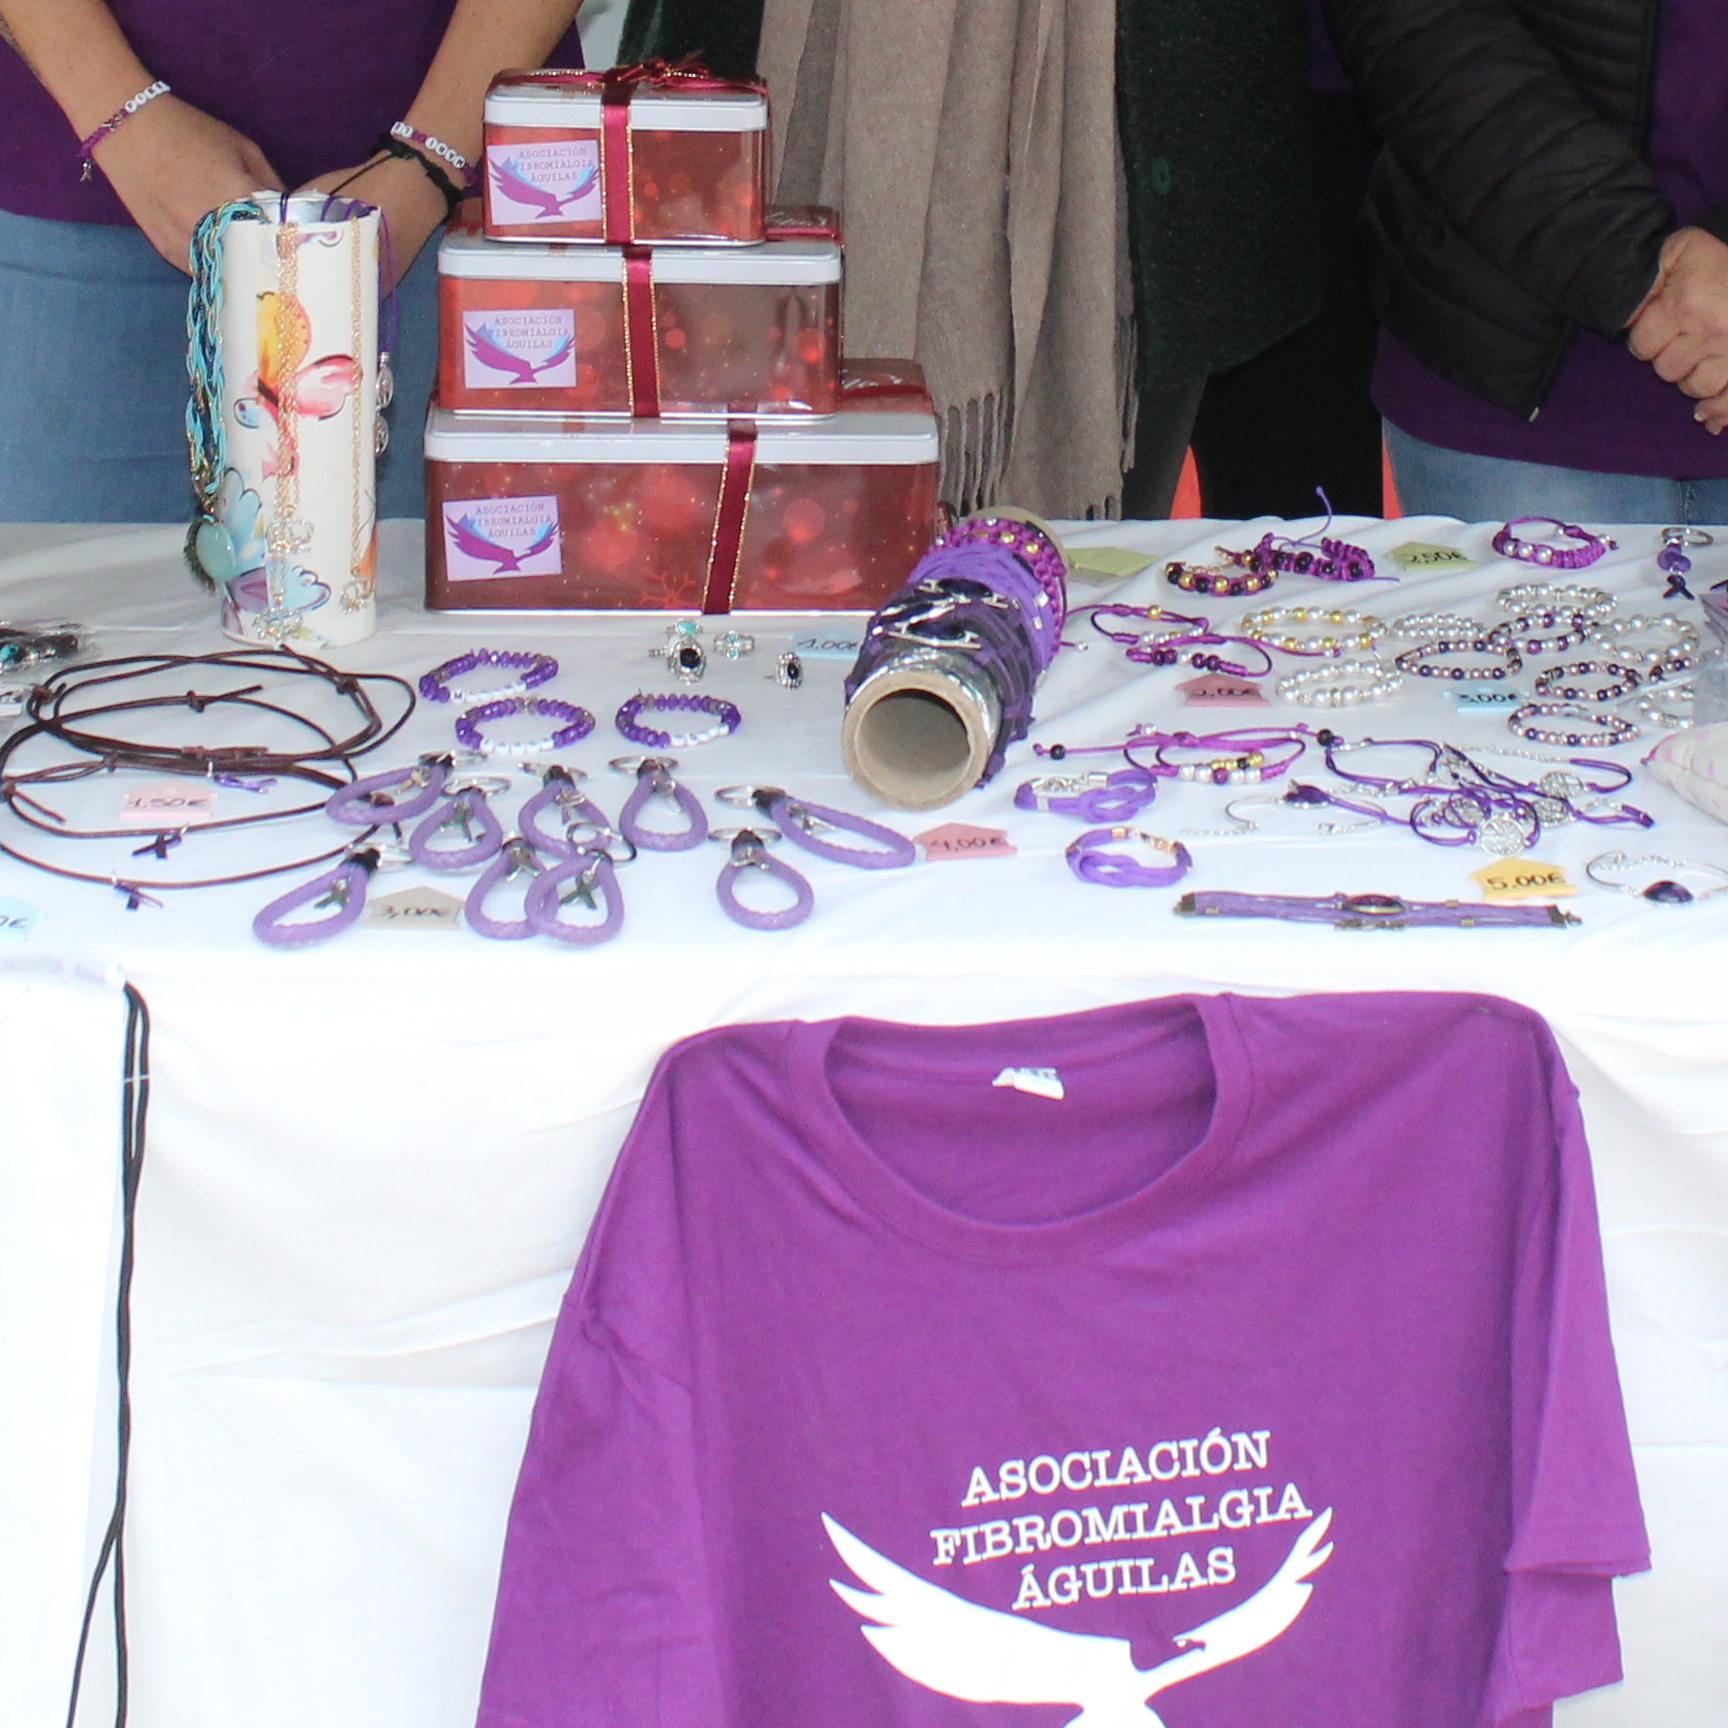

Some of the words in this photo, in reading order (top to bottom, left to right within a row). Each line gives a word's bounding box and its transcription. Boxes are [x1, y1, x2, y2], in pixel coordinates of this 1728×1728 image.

[960, 1425, 1272, 1508] ASOCIACIÓN
[928, 1481, 1314, 1567] FIBROMIALGIA
[1011, 1545, 1238, 1612] ÁGUILAS
